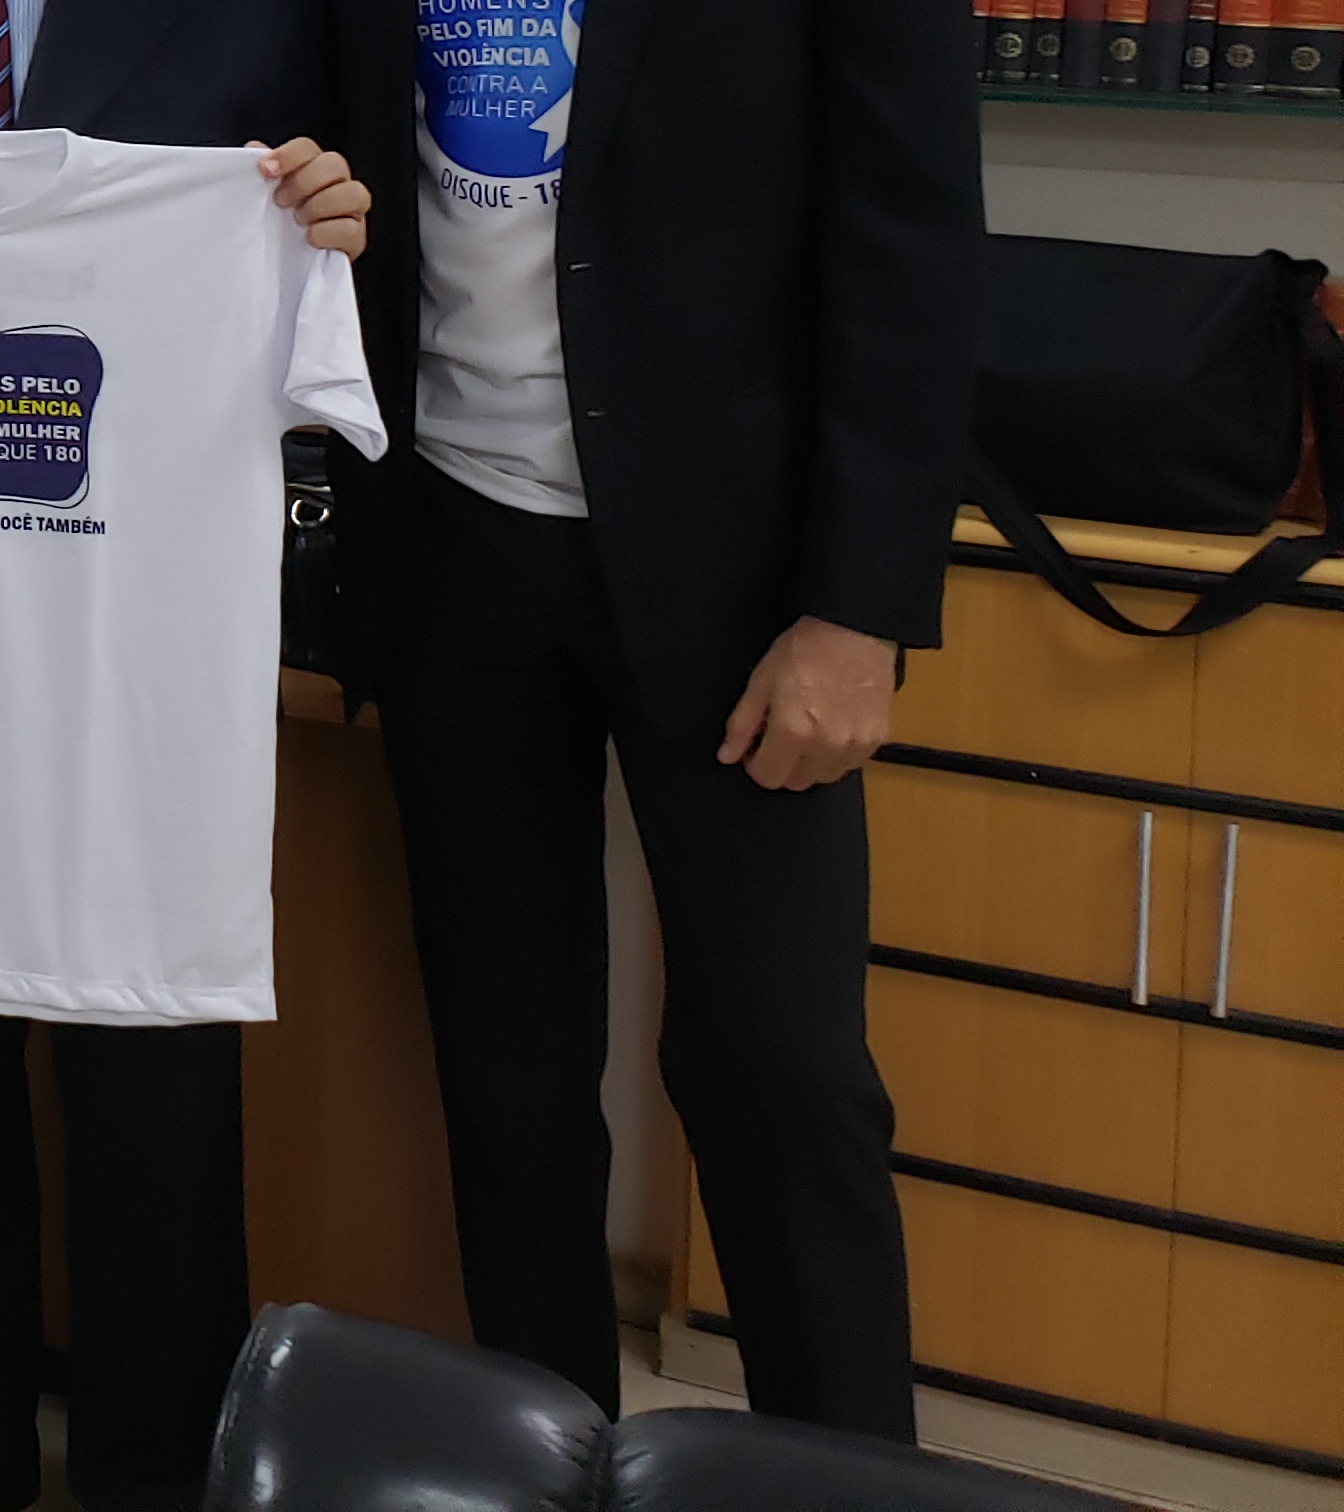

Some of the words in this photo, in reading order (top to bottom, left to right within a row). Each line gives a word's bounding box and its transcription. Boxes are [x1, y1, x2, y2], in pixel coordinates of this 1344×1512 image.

[416, 19, 472, 43] PELO
[476, 18, 513, 38] FIM
[521, 18, 557, 37] DA
[433, 42, 551, 68] VIOLÊNCIA
[446, 74, 532, 96] CONTRA
[533, 75, 549, 95] A
[445, 99, 536, 119] MULHER
[440, 168, 513, 209] DISQUE
[21, 376, 80, 394] PELO
[43, 445, 82, 463] 180
[36, 516, 106, 534] TAMBÉM
